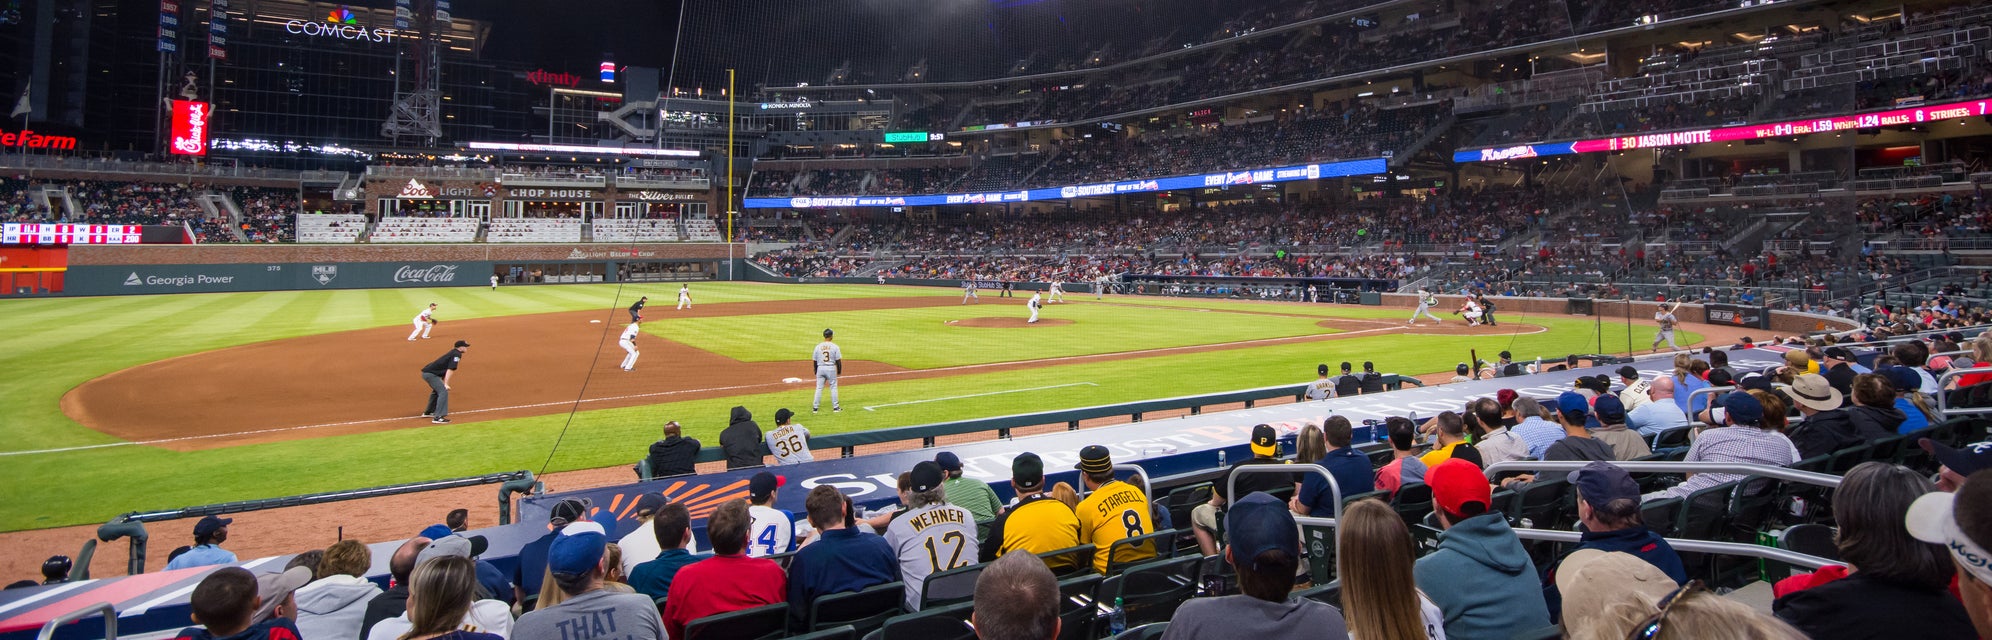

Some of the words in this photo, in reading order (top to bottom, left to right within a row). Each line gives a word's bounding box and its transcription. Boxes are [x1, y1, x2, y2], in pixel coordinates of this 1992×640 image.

[286, 20, 395, 43] COMCAST
[527, 68, 581, 88] xfinity
[1622, 137, 1636, 149] 30
[1638, 133, 1671, 148] JASON
[1673, 130, 1712, 145] MOTTE
[1775, 124, 1792, 136] 0-0
[1793, 124, 1811, 134] ERA:
[1812, 121, 1833, 133] 1.59
[1834, 119, 1858, 131] WHIP:
[1859, 115, 1880, 128] 1.24
[1881, 114, 1910, 125] BALLS:
[1915, 109, 1924, 122] 6
[1930, 107, 1970, 120] STRIKES:
[1978, 101, 1986, 115] 7
[892, 133, 921, 141] StubHub
[1205, 174, 1226, 186] EVERY
[1253, 170, 1274, 182] GAME
[440, 188, 473, 197] LIGHT
[511, 188, 545, 198] CHOP
[550, 189, 592, 199] HOUSE
[640, 190, 675, 200] Silver
[1077, 184, 1115, 196] SOUTHEAST
[812, 197, 858, 207] SOUTHEAST
[129, 226, 136, 234] 2
[146, 275, 195, 286] Georgia
[198, 274, 234, 284] Power
[393, 264, 460, 283] Coca-Cola
[822, 351, 830, 363] 3
[775, 434, 803, 458] 36
[1260, 437, 1268, 446] P
[1097, 490, 1144, 518] STARGELL
[909, 508, 965, 533] WEHNER
[1122, 508, 1145, 546] 8
[924, 530, 968, 574] 12
[555, 606, 616, 640] THAT
